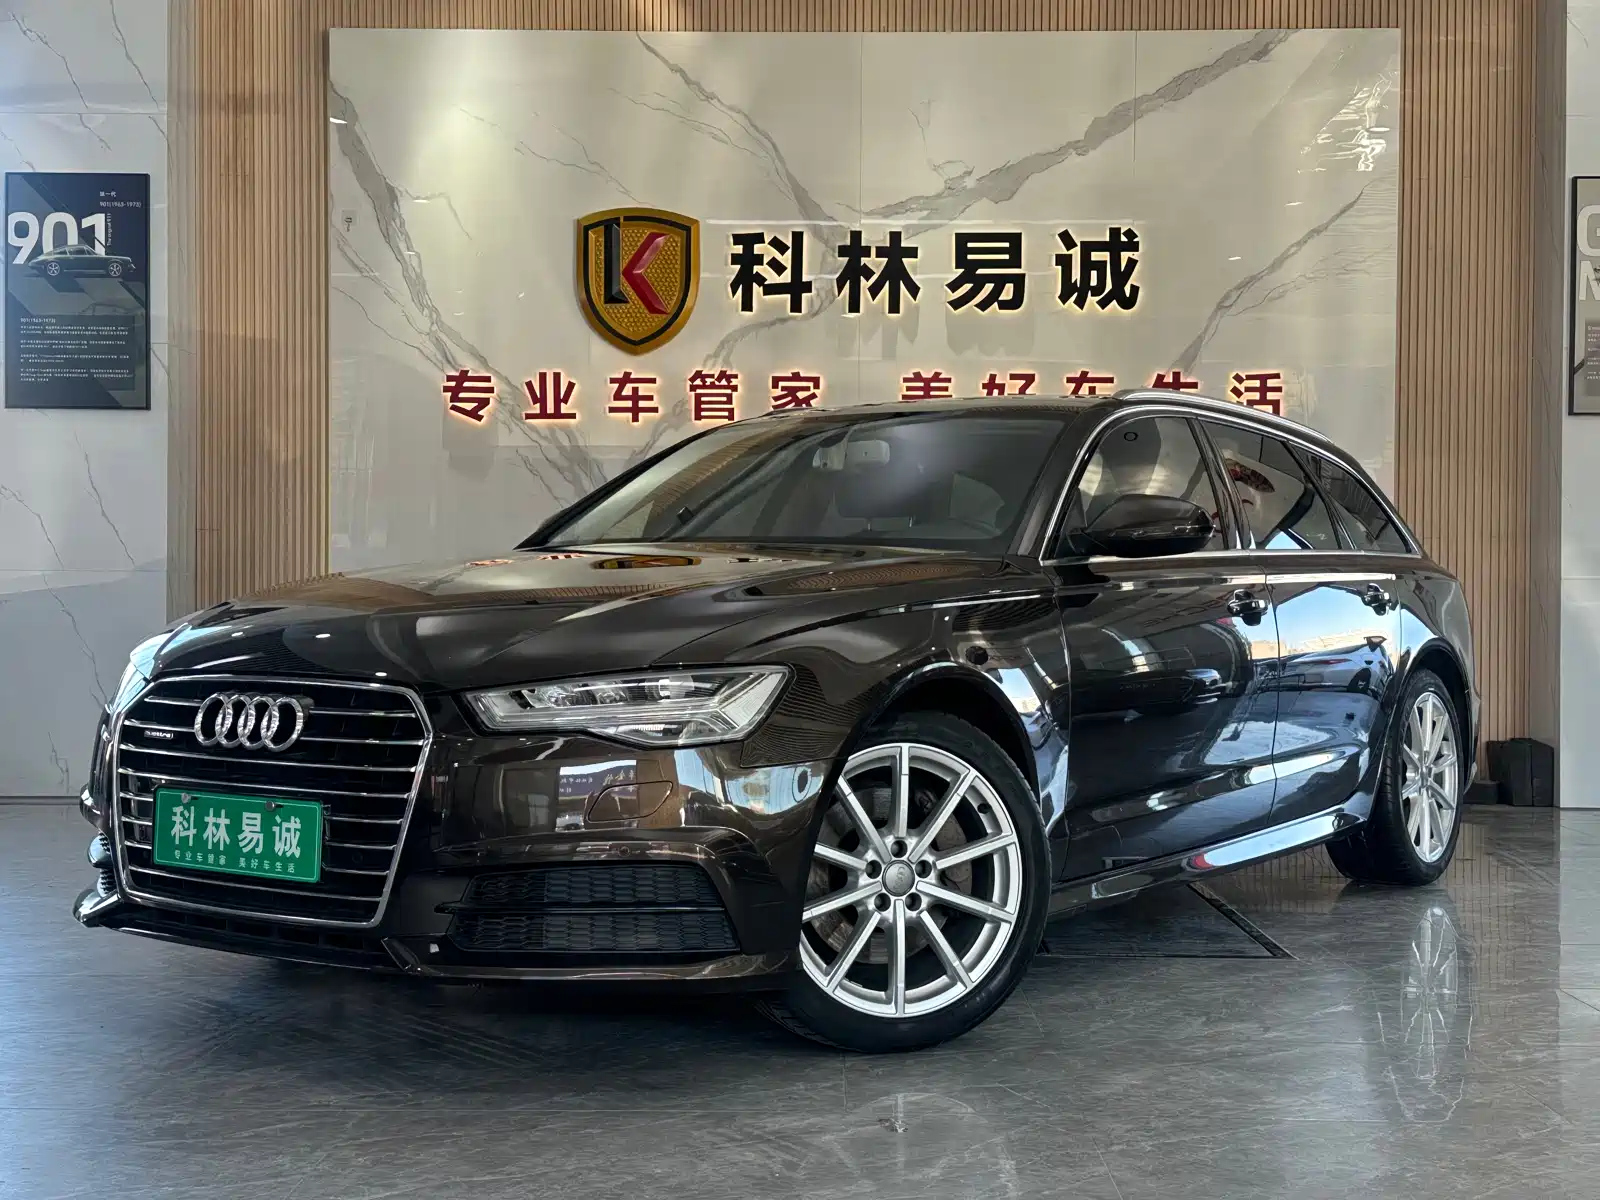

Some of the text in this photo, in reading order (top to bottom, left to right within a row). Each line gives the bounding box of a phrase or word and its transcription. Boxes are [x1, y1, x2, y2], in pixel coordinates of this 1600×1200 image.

[7, 211, 106, 265] 901
[729, 226, 1140, 314] 科林易诚
[442, 369, 821, 423] 专业车管家
[170, 805, 302, 858] 科林易诚
